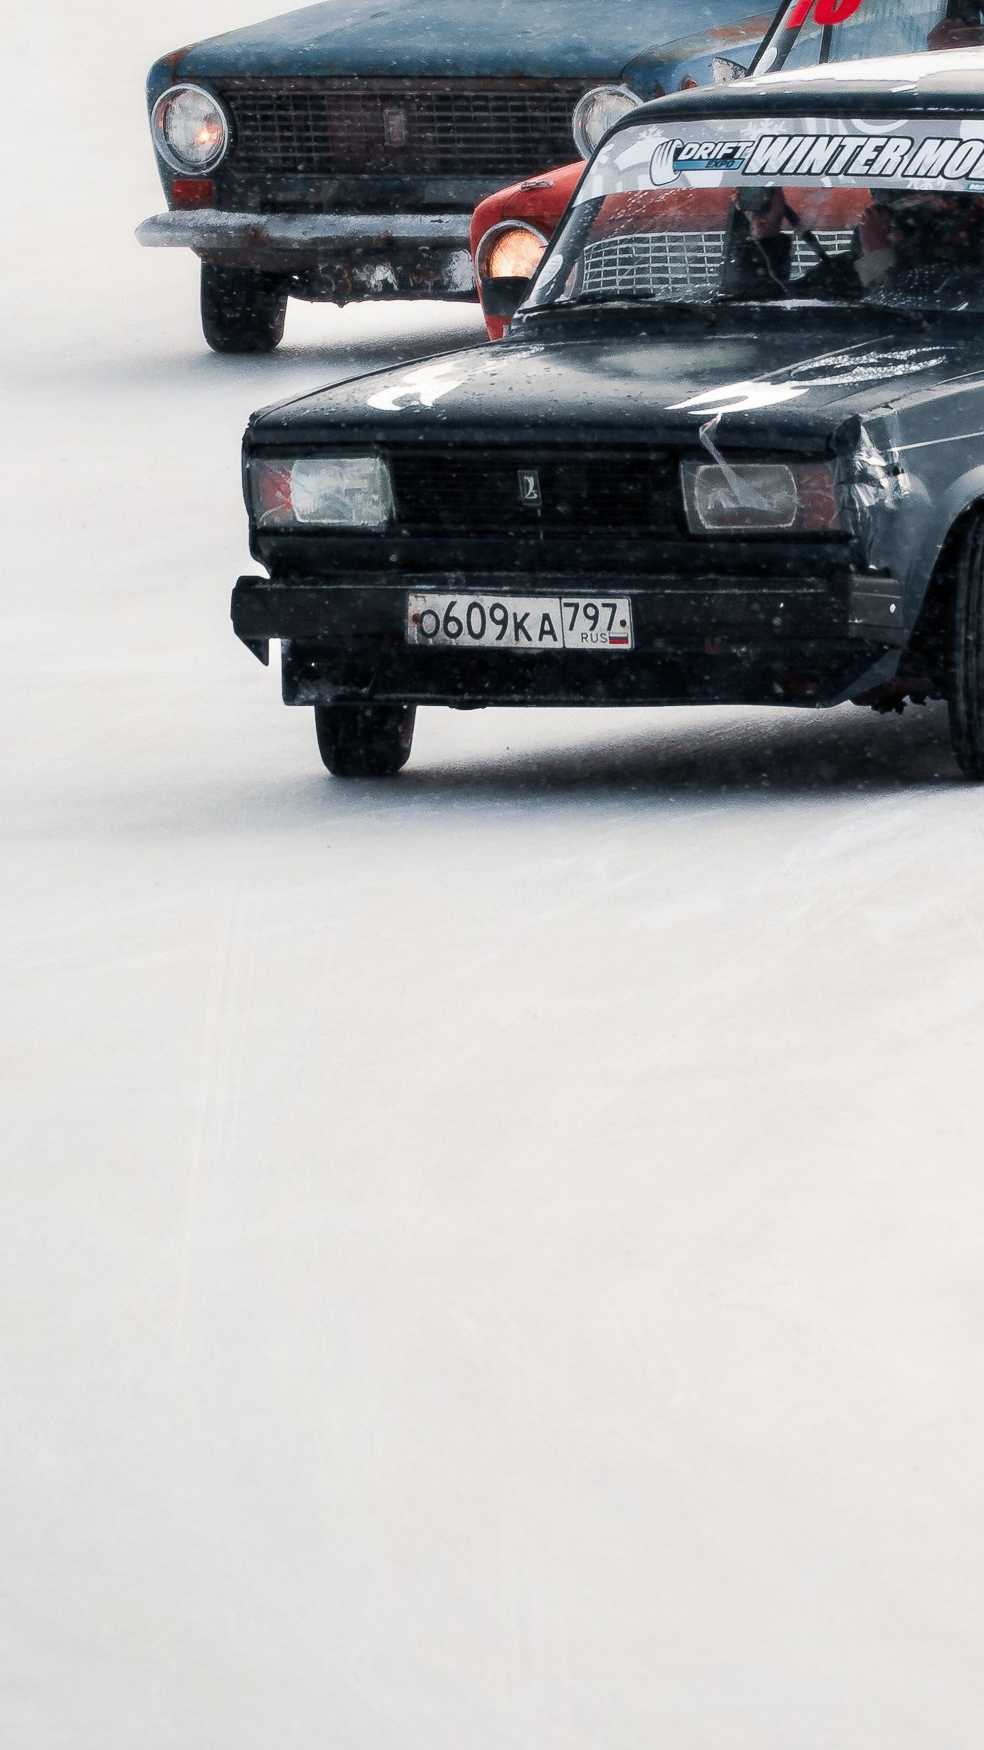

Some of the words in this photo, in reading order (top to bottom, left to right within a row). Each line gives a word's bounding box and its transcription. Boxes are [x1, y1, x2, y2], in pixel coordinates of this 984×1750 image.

[677, 140, 755, 161] DRIFT
[741, 134, 916, 177] WINTER
[705, 159, 735, 169] EXPO
[419, 600, 558, 643] O609KA
[563, 602, 618, 632] 797
[581, 632, 609, 644] RUS
